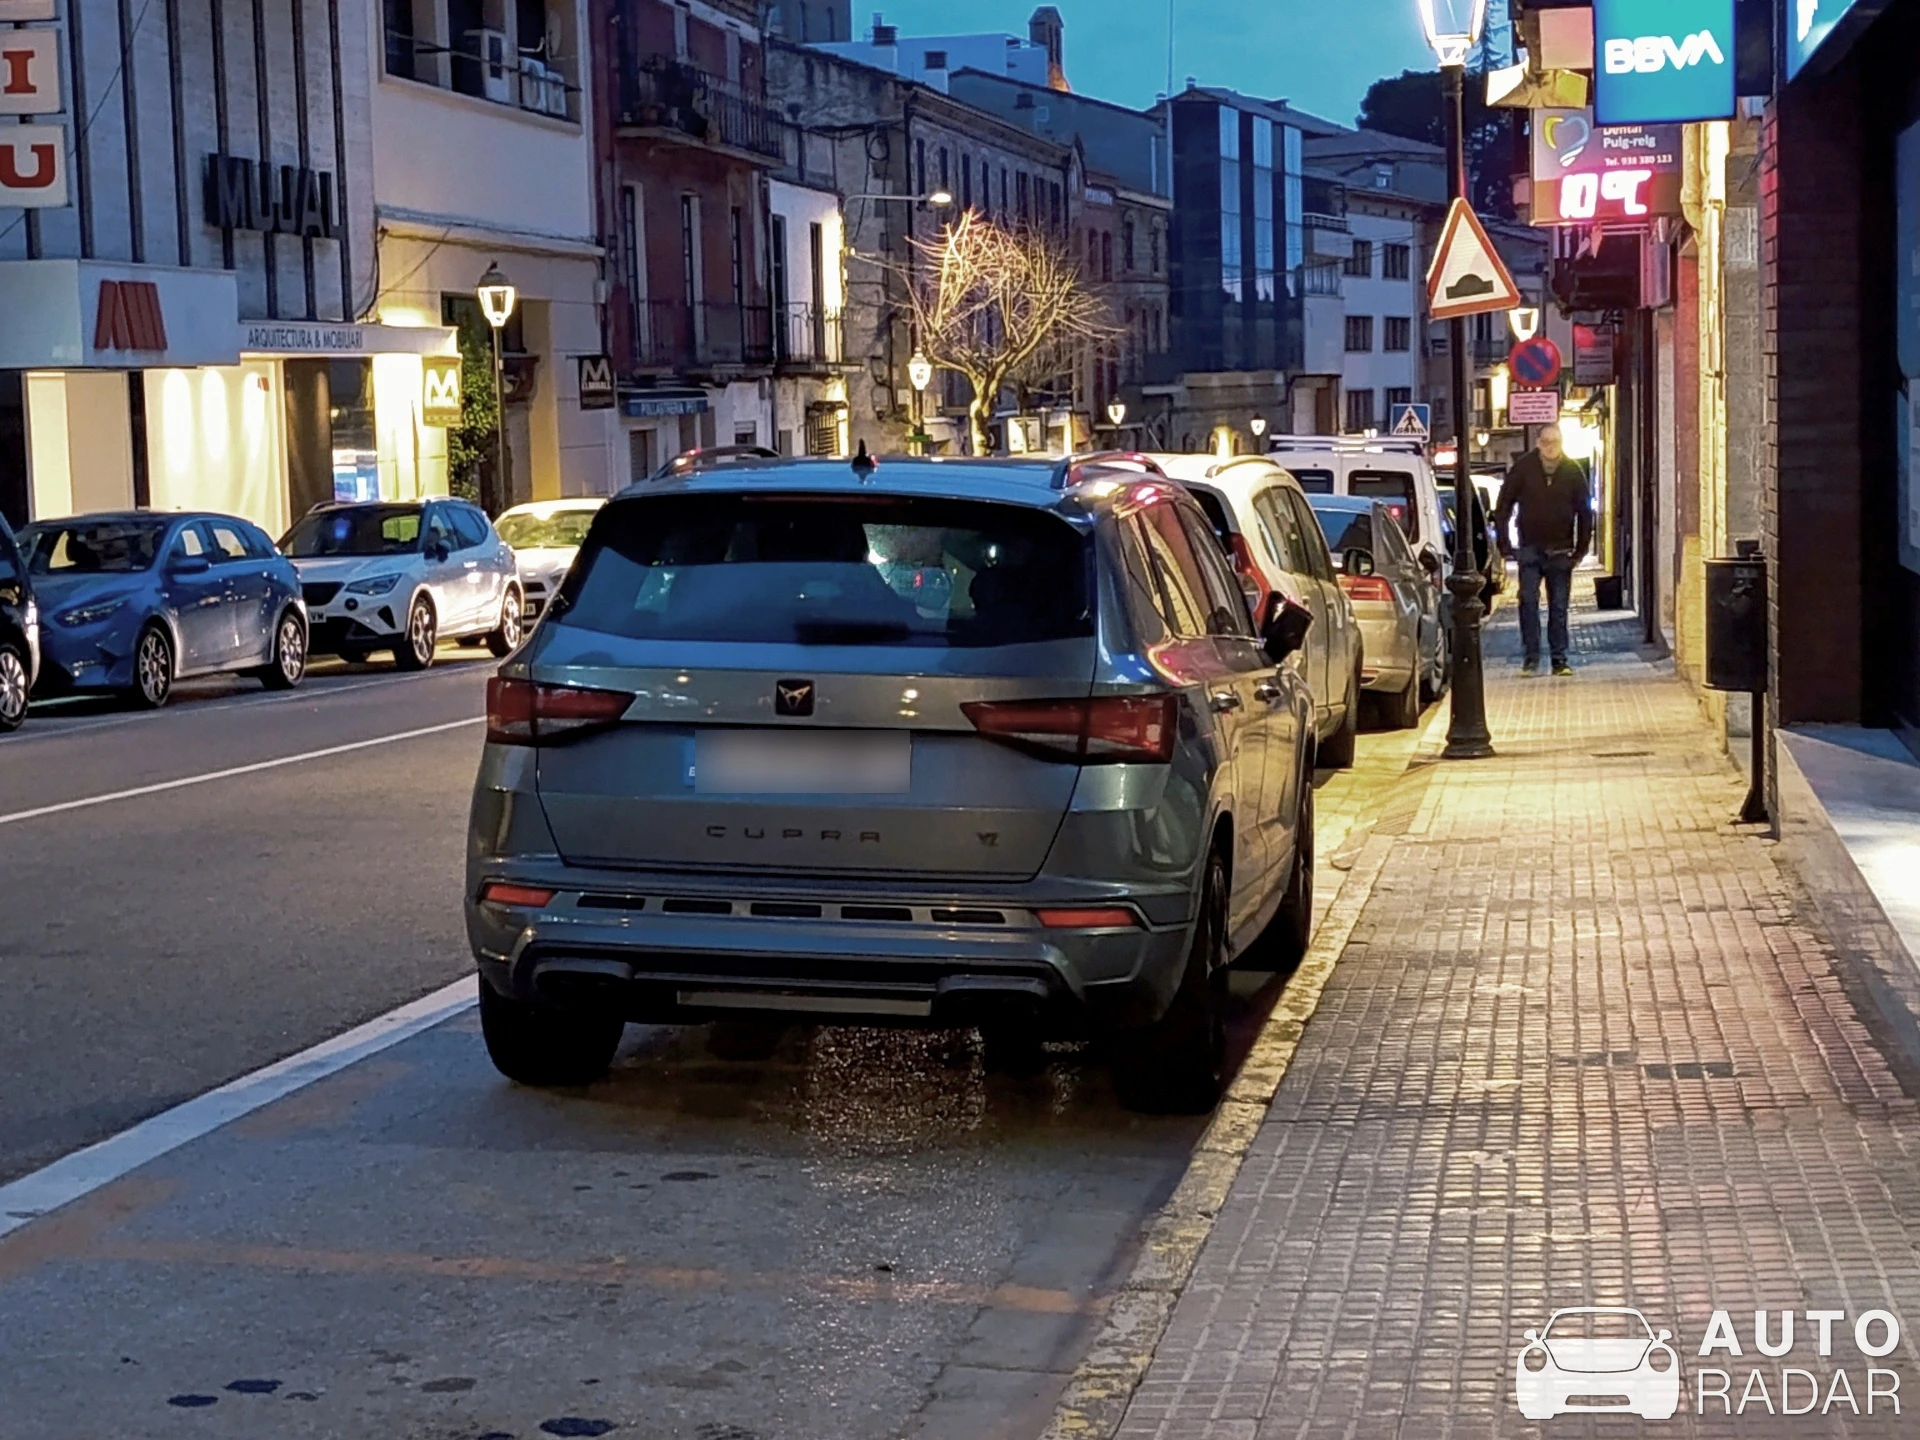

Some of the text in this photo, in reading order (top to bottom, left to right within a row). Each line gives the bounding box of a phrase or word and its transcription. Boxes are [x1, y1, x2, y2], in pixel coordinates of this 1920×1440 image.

[1605, 29, 1724, 74] BBVA
[1603, 134, 1656, 149] Puig-reig
[207, 153, 348, 240] MUJAL
[248, 327, 313, 349] ARQUITECTURA
[706, 825, 881, 844] CUPRA
